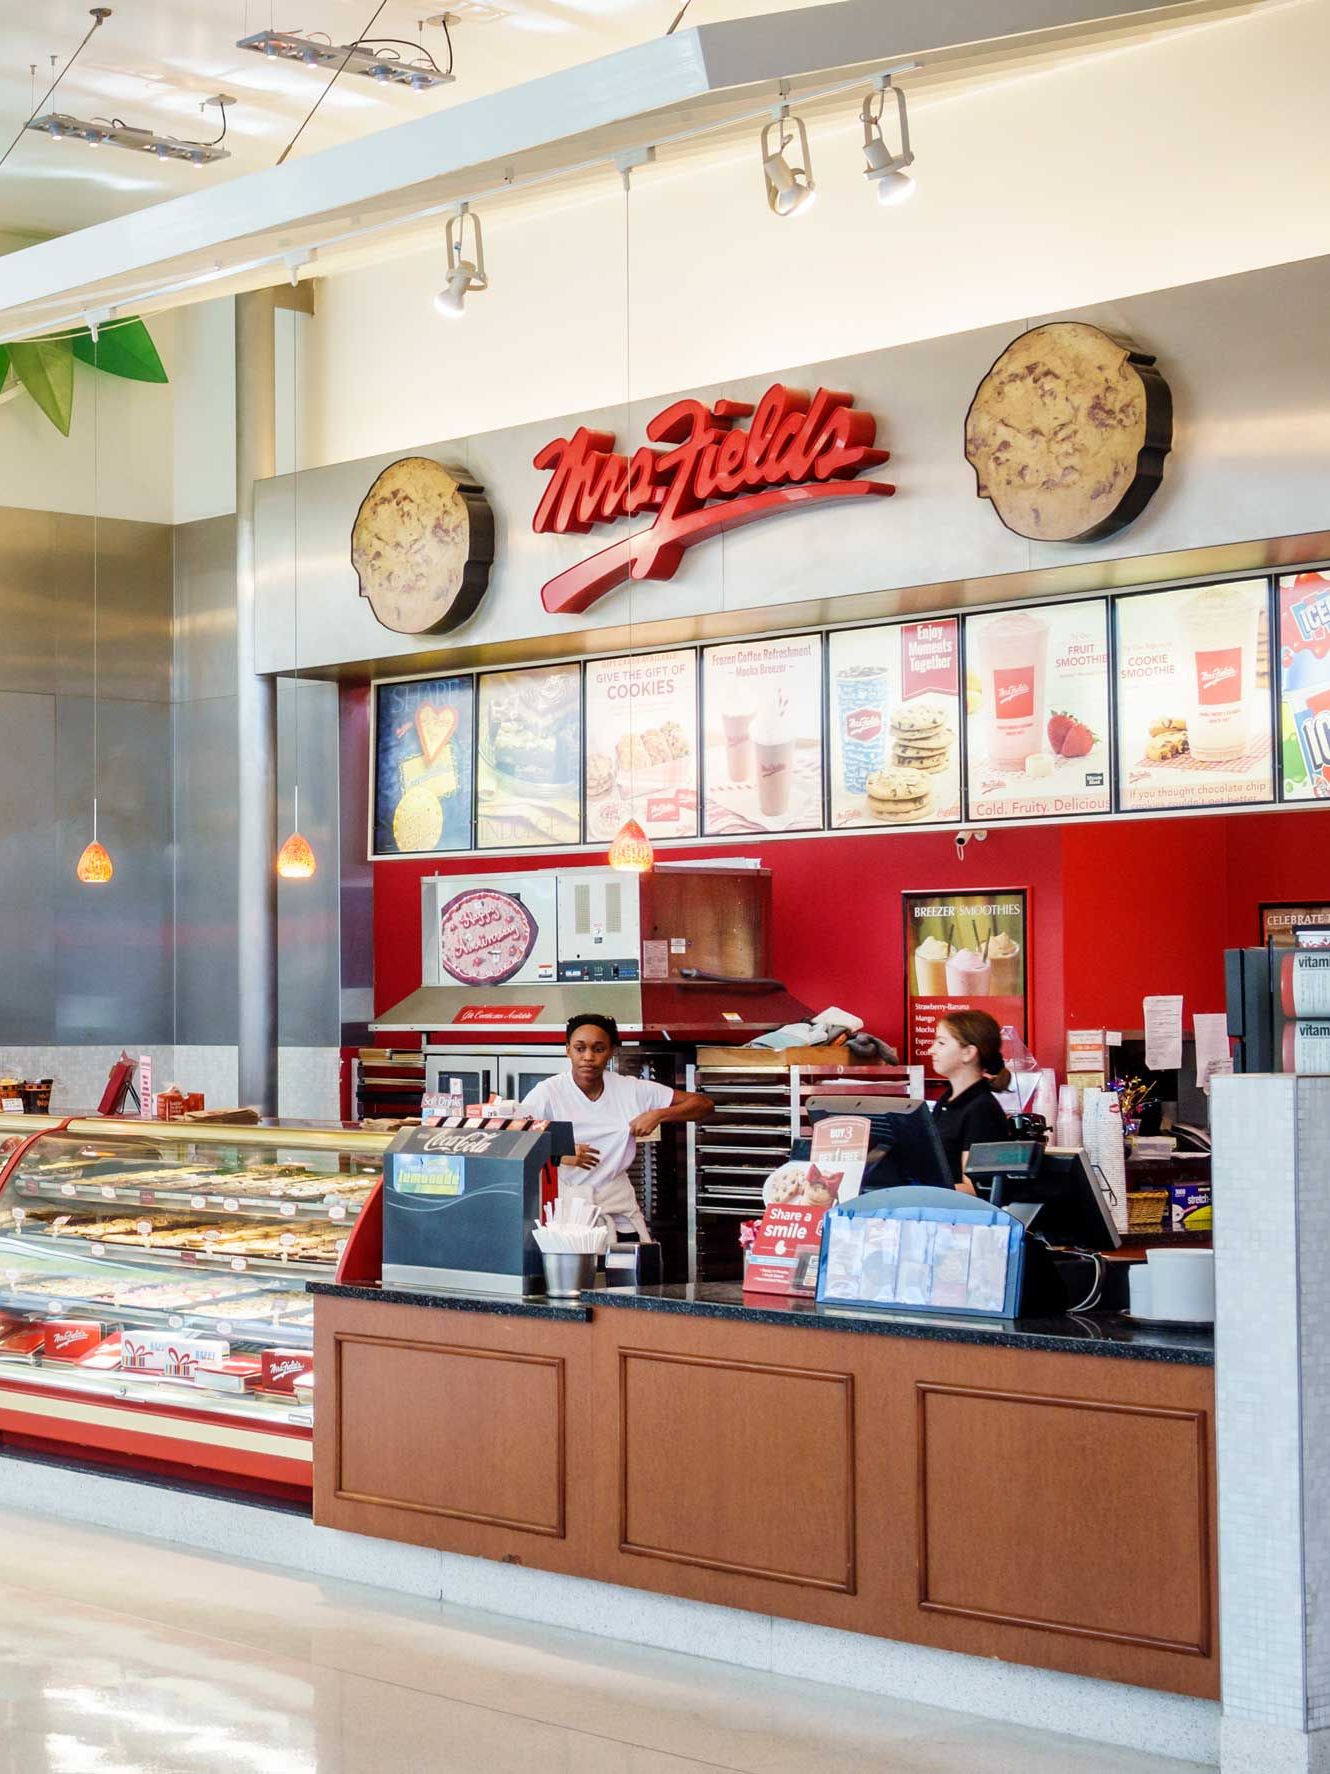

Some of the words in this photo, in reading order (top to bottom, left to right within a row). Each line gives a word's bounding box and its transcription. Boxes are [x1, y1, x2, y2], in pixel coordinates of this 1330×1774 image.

[631, 383, 892, 581] Fields
[917, 625, 943, 642] Enjoy
[711, 654, 736, 667] Frozen
[737, 650, 762, 664] Coffee
[763, 643, 812, 661] Refreshment
[908, 640, 953, 656] Moments
[1068, 644, 1094, 655] FRUIT
[910, 655, 951, 673] Together
[1128, 654, 1169, 666] COOKIE
[596, 672, 620, 683] GIVE
[623, 669, 642, 681] THE
[645, 666, 668, 678] GIFT
[671, 664, 686, 675] OF
[1121, 665, 1175, 679] SMOOTHIE
[390, 678, 459, 713] SHARE
[607, 679, 675, 700] COOKIES
[1130, 790, 1137, 799] If
[1139, 791, 1156, 801] you
[1158, 787, 1195, 799] thought
[1197, 783, 1243, 795] chocolate
[1246, 781, 1267, 793] chip
[976, 802, 1008, 817] Cold.
[1012, 800, 1050, 816] Fruity.
[1054, 795, 1109, 811] Delicious
[459, 905, 501, 929] Happy
[914, 906, 955, 918] BREEZER
[958, 904, 1021, 915] SMOOTHIES
[1267, 914, 1324, 926] CELEBRATE
[915, 1015, 936, 1023] Mango
[423, 1095, 437, 1107] Soft
[438, 1096, 461, 1108] Drinks
[830, 1127, 845, 1138] BUY
[845, 1126, 852, 1140] 3
[424, 1131, 501, 1154] Coca-Cola
[769, 1208, 802, 1222] Share
[804, 1212, 813, 1222] a
[764, 1223, 807, 1240] smile
